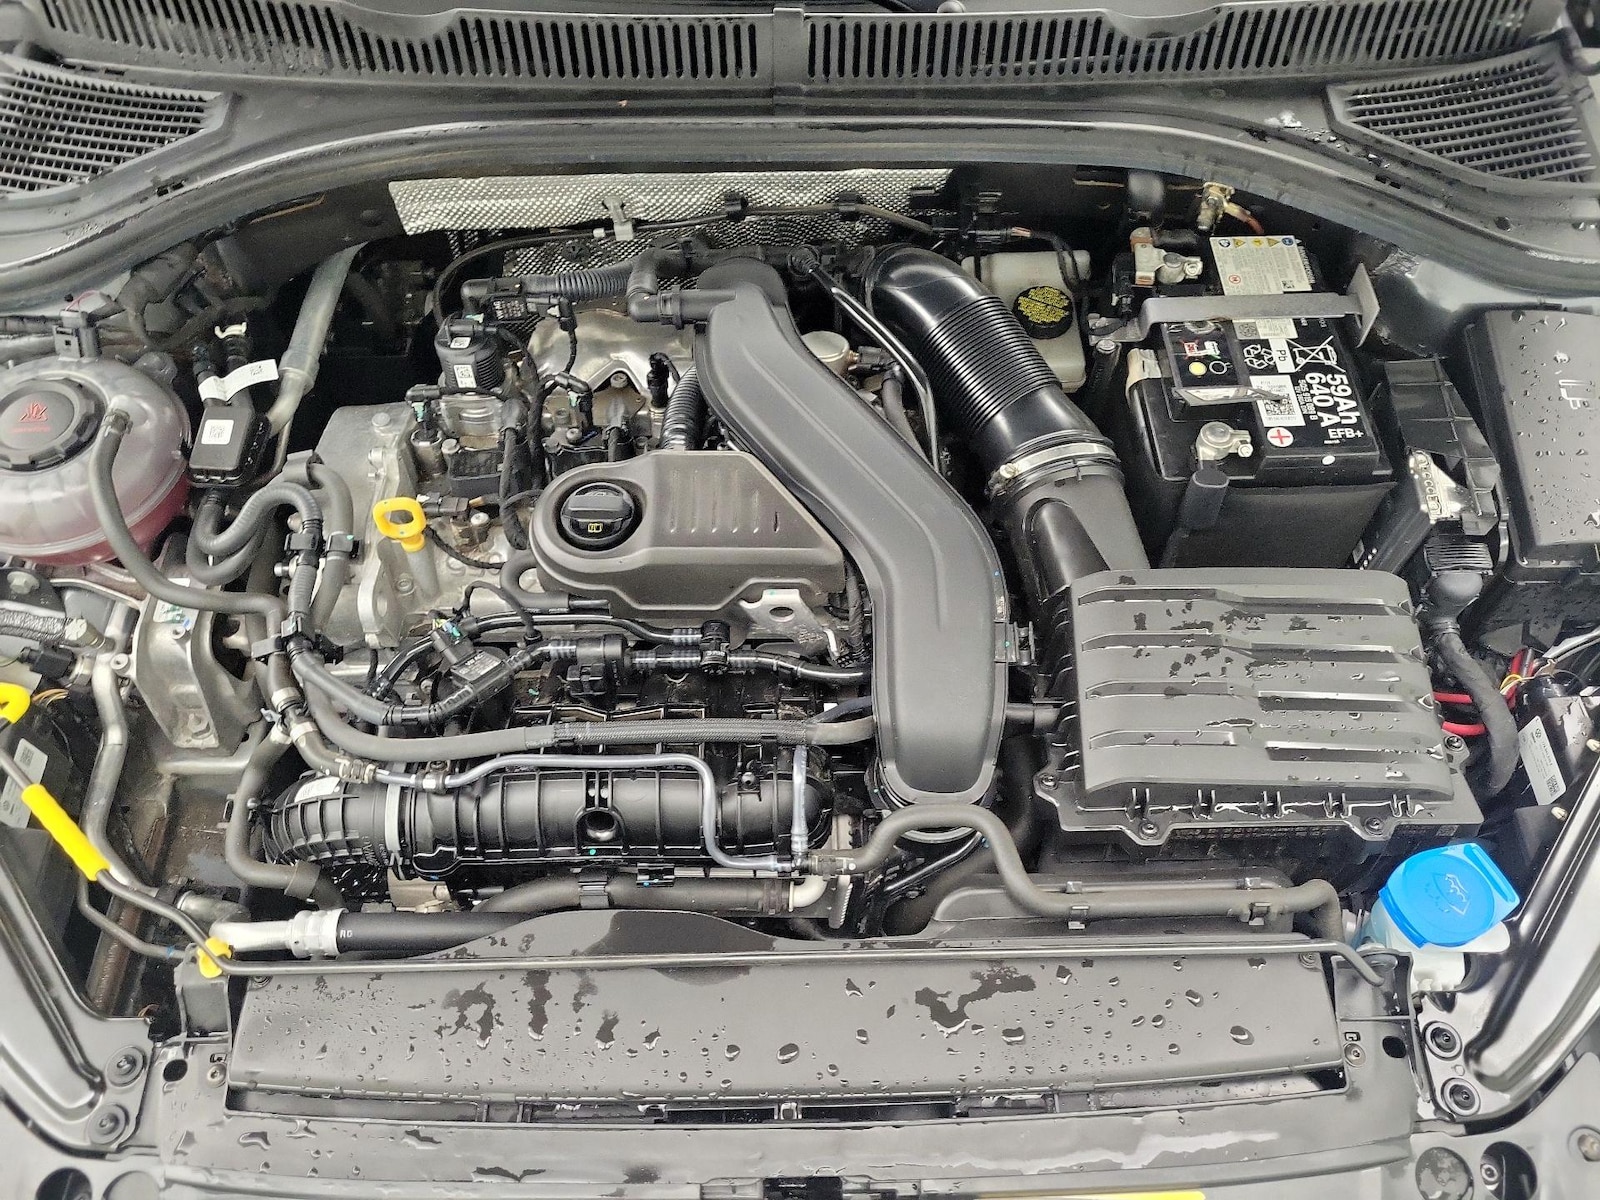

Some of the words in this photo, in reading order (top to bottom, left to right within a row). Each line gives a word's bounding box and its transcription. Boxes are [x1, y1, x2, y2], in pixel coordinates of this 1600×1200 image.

[1276, 349, 1287, 362] Pb
[1305, 372, 1335, 408] 640
[1326, 373, 1361, 425] 59Ah
[1317, 411, 1341, 428] A
[1327, 428, 1364, 439] EFB+
